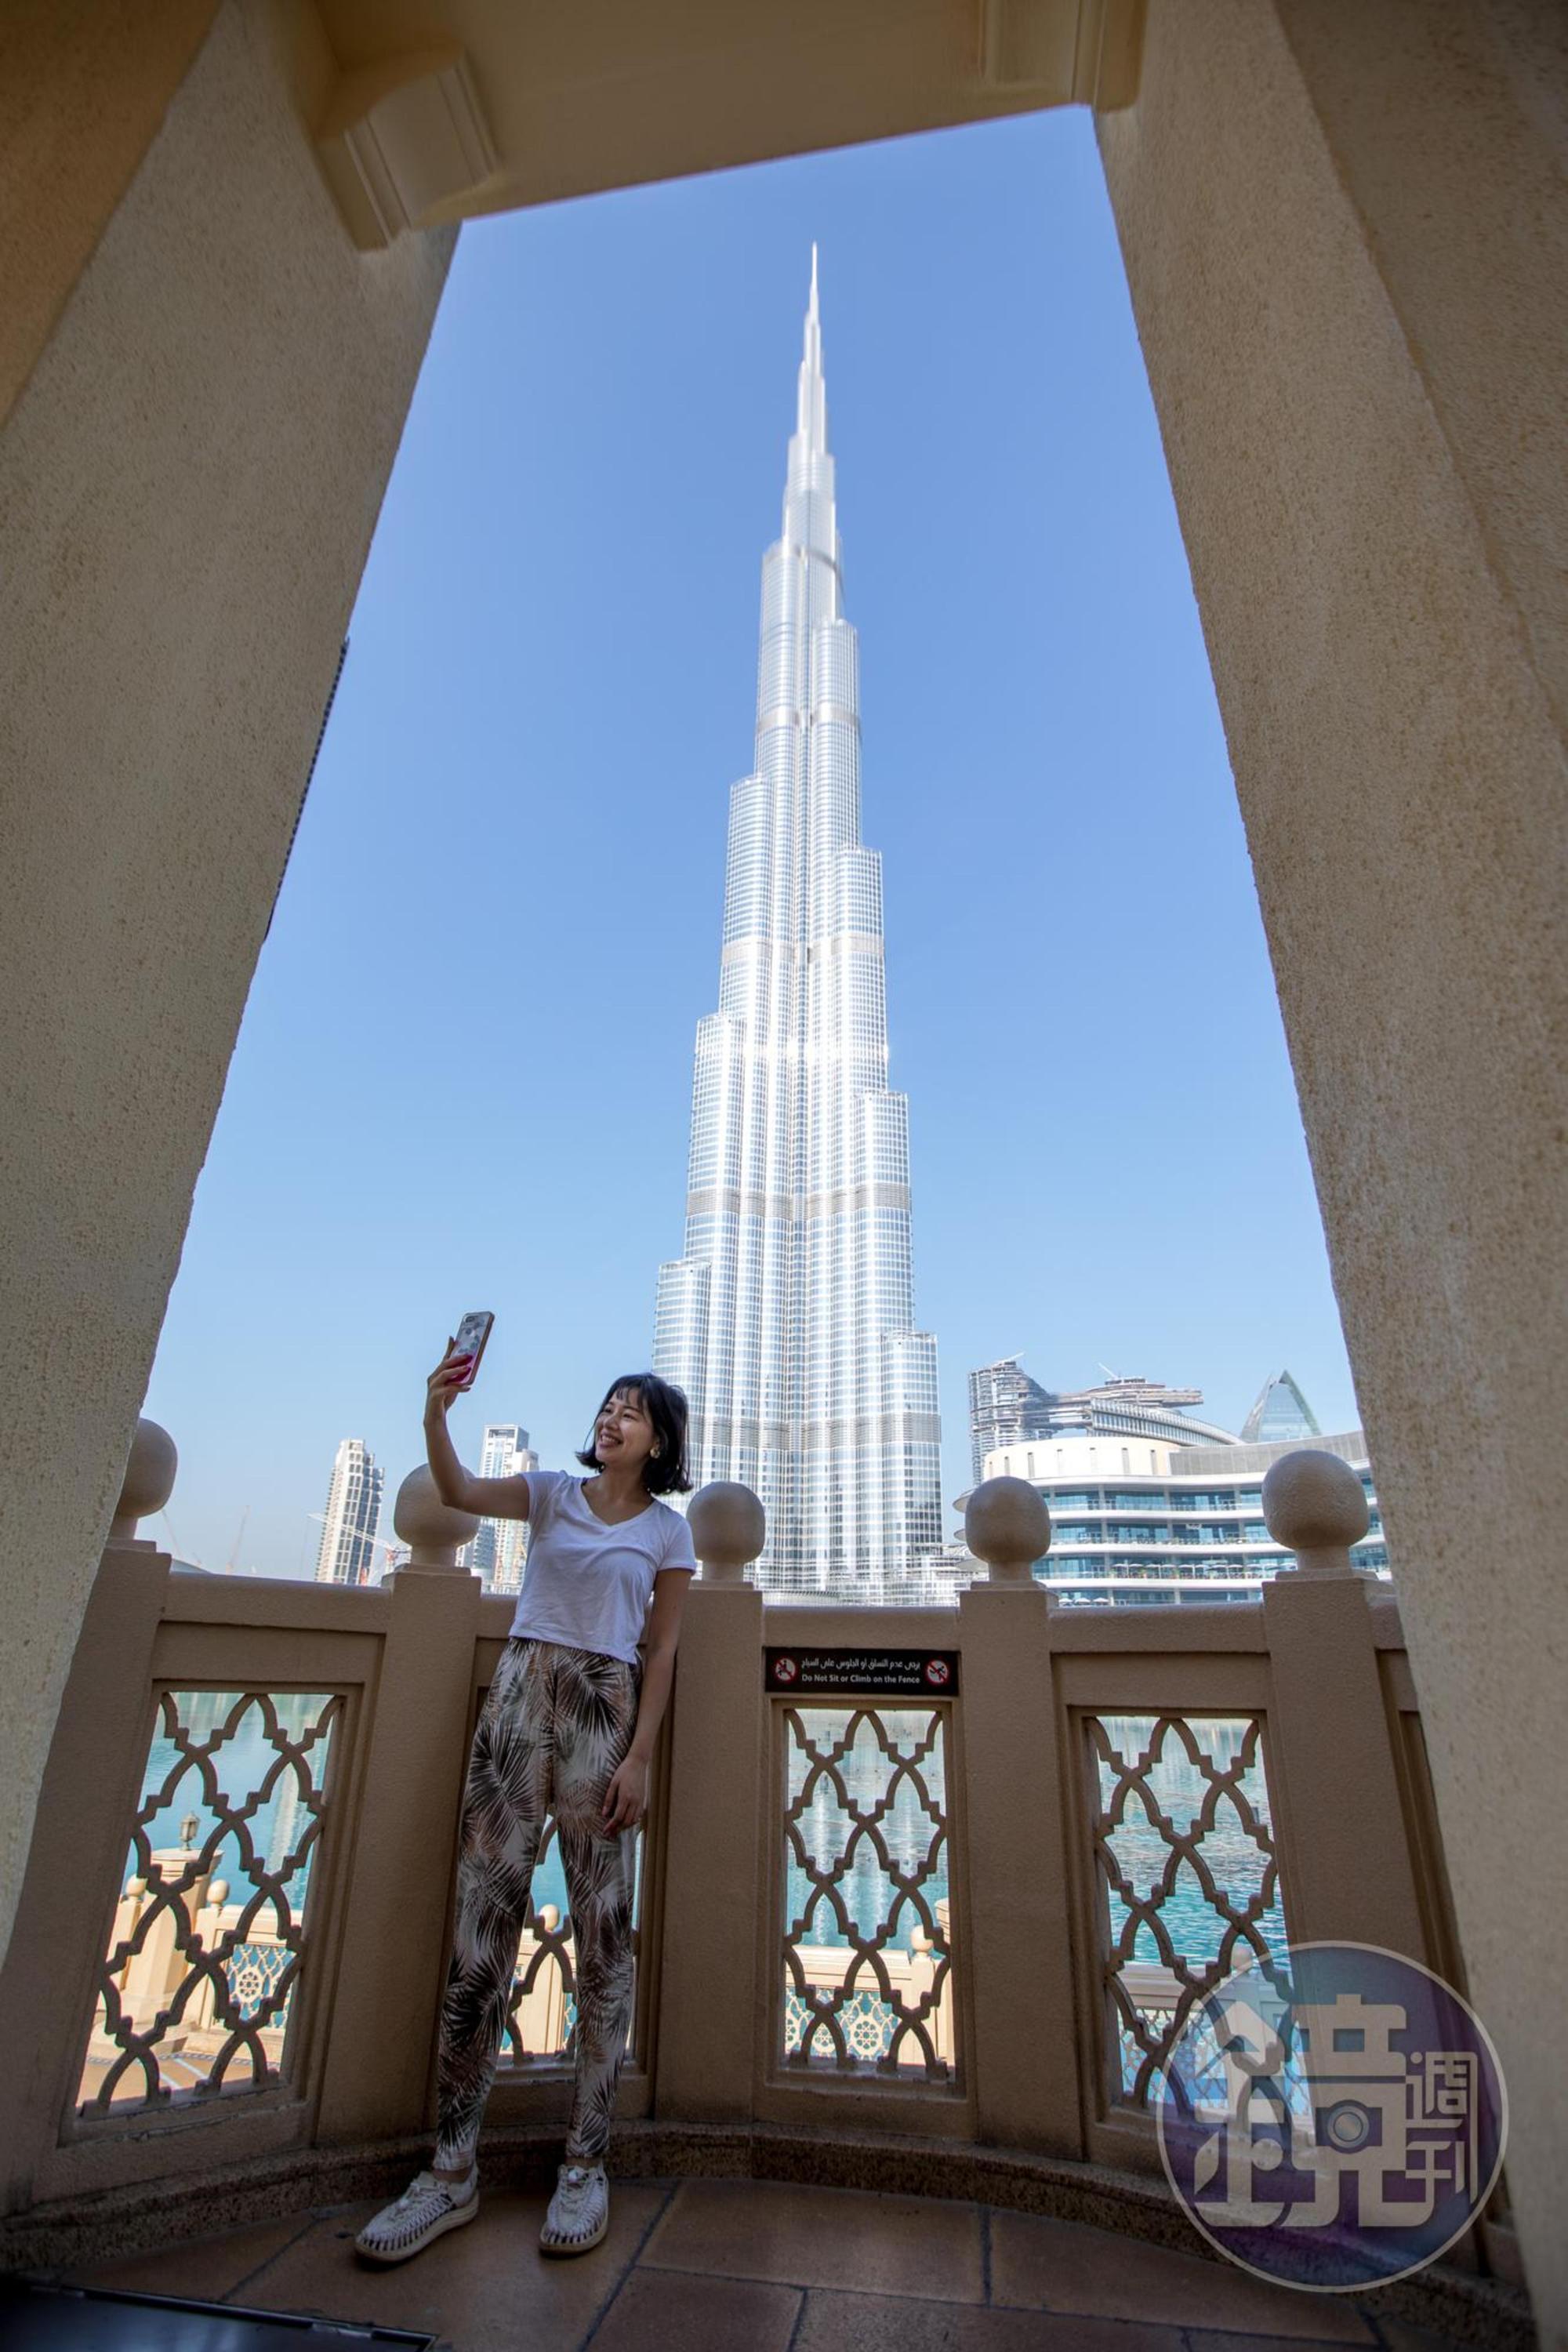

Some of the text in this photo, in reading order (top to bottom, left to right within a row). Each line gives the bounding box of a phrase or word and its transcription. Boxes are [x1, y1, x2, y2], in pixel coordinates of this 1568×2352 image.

[814, 1674, 827, 1682] Not
[829, 1674, 839, 1682] Sit
[851, 1674, 871, 1682] Climb
[884, 1675, 896, 1683] the
[898, 1675, 920, 1684] Fence
